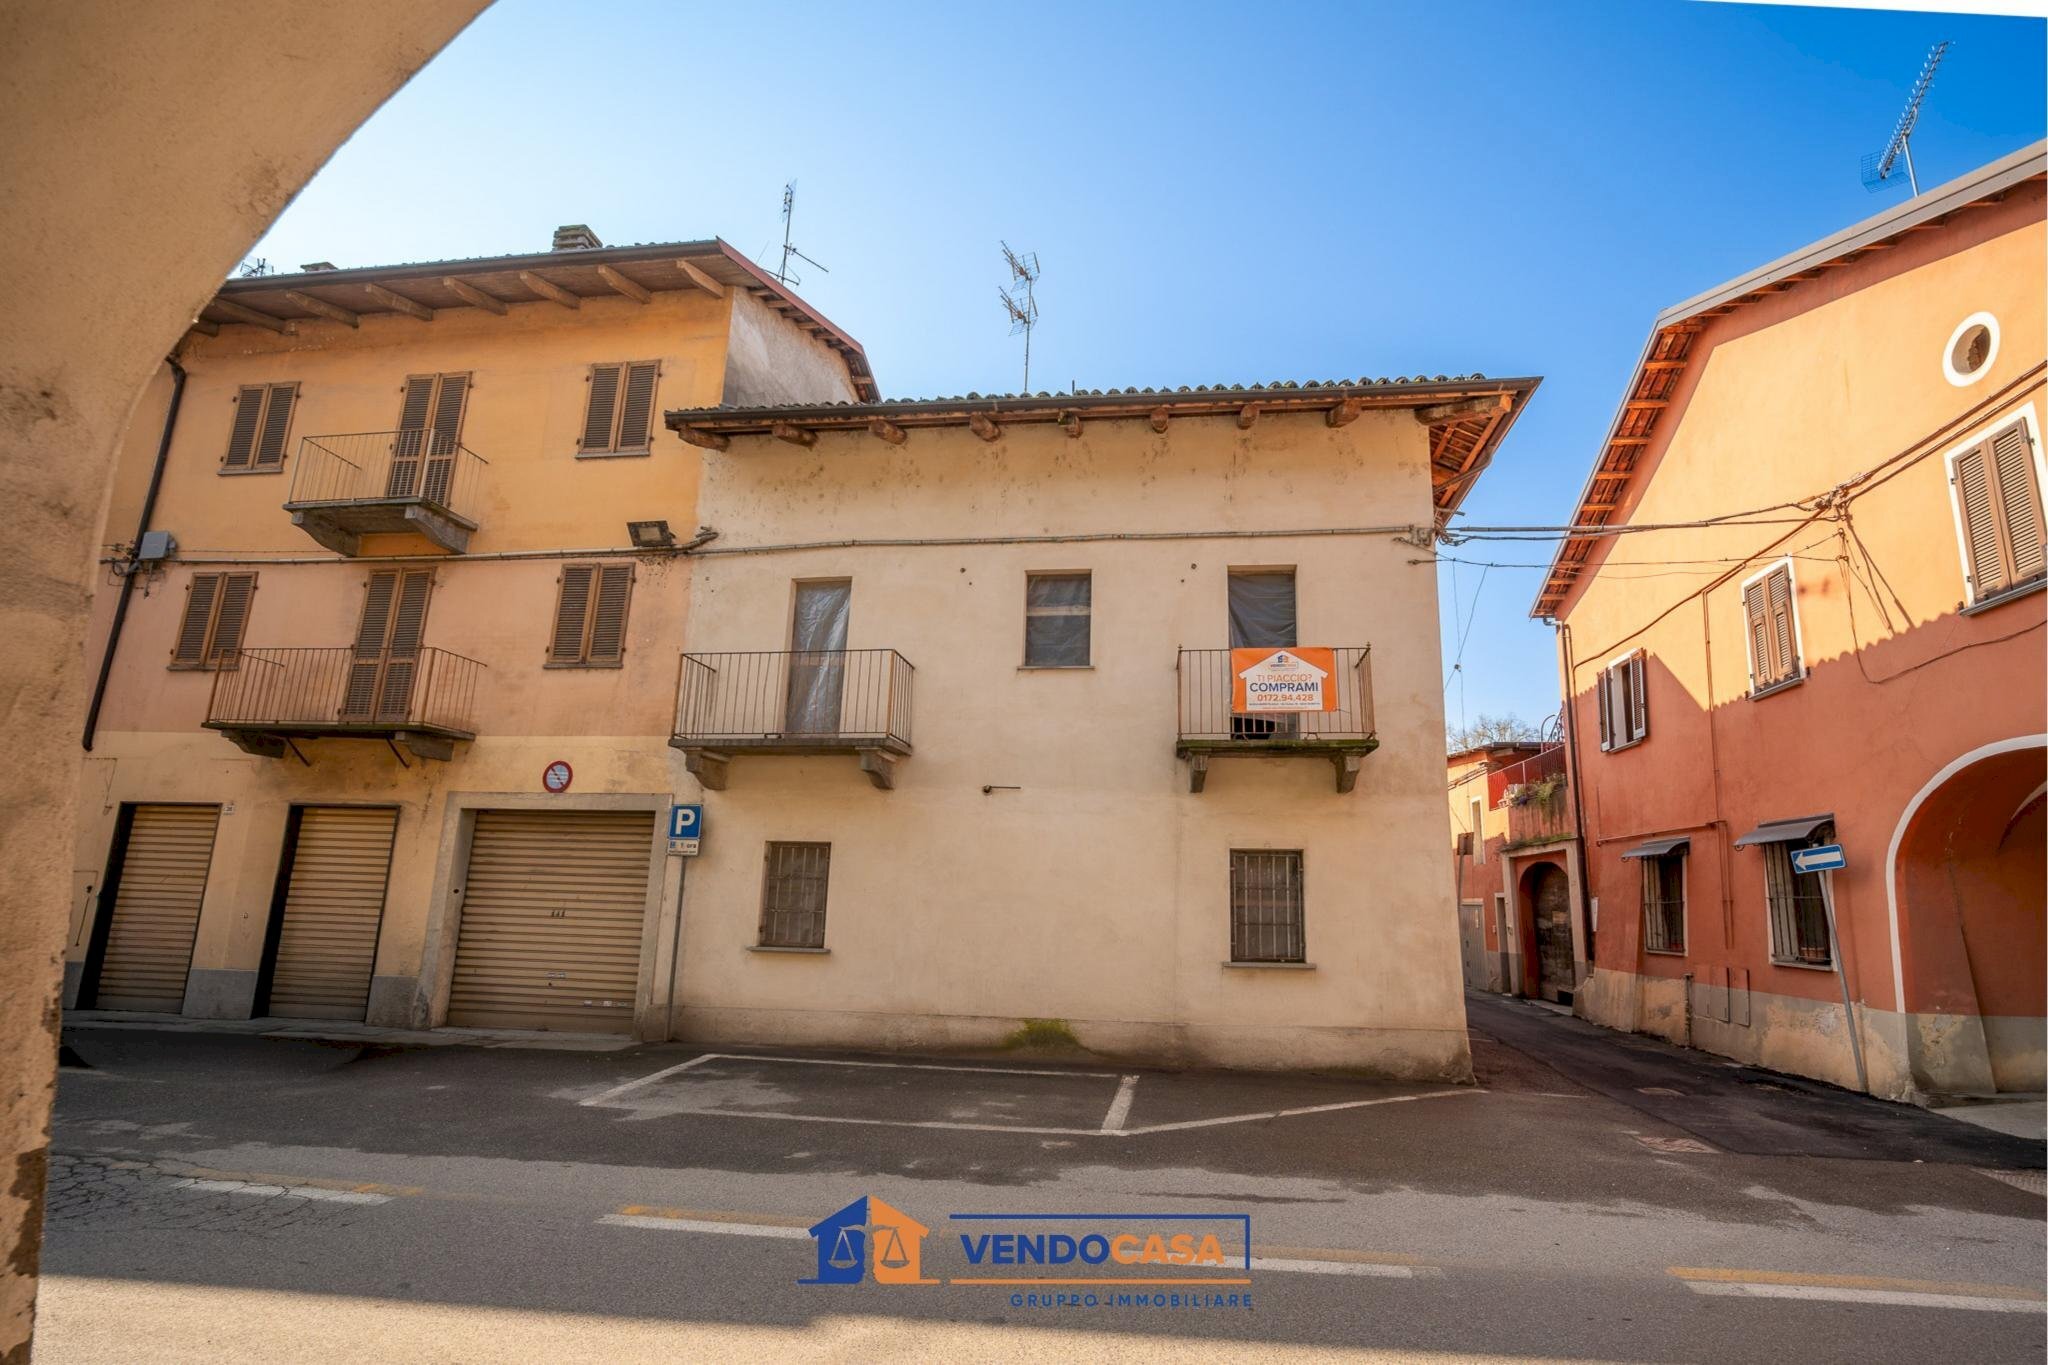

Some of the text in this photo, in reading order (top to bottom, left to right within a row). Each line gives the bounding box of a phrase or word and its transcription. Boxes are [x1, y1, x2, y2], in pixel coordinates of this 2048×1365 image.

[1256, 674, 1312, 682] TI PIACCIO?
[1249, 682, 1318, 692] COMPRAMI
[675, 809, 696, 834] P
